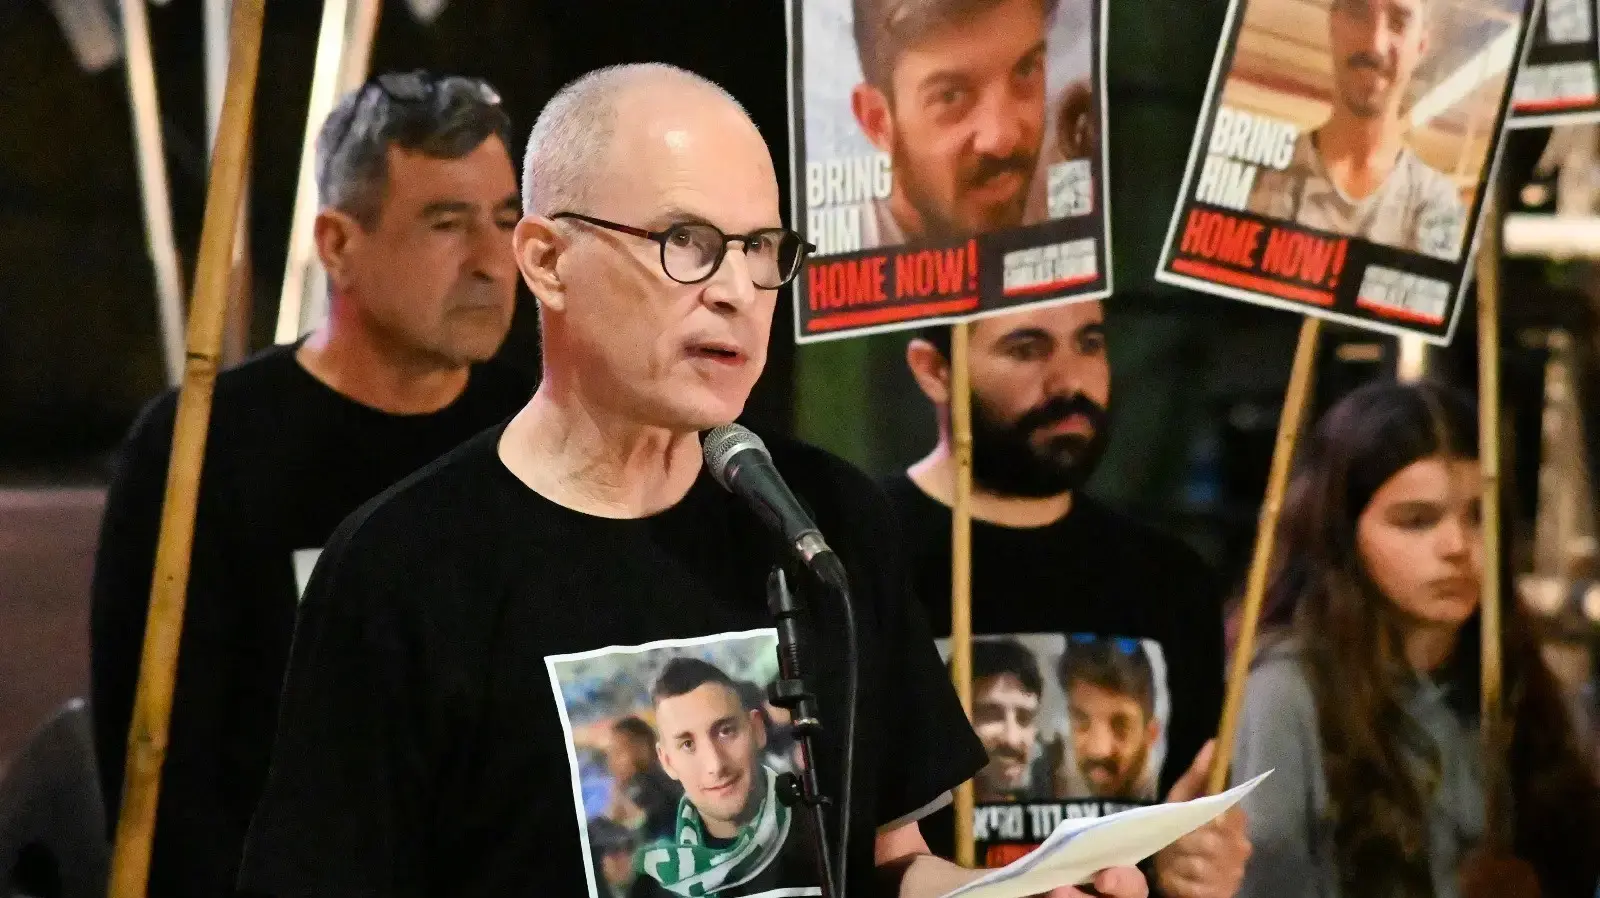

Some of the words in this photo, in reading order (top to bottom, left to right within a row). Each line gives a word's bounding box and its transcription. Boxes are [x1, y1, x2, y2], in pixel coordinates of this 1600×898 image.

[1209, 108, 1296, 169] BRING
[806, 154, 892, 207] BRING
[1195, 155, 1258, 211] HIM
[807, 206, 861, 257] HIM
[1181, 209, 1262, 267] HOME
[1262, 229, 1348, 288] NOW!
[808, 257, 886, 310] HOME
[896, 240, 976, 297] NOW!
